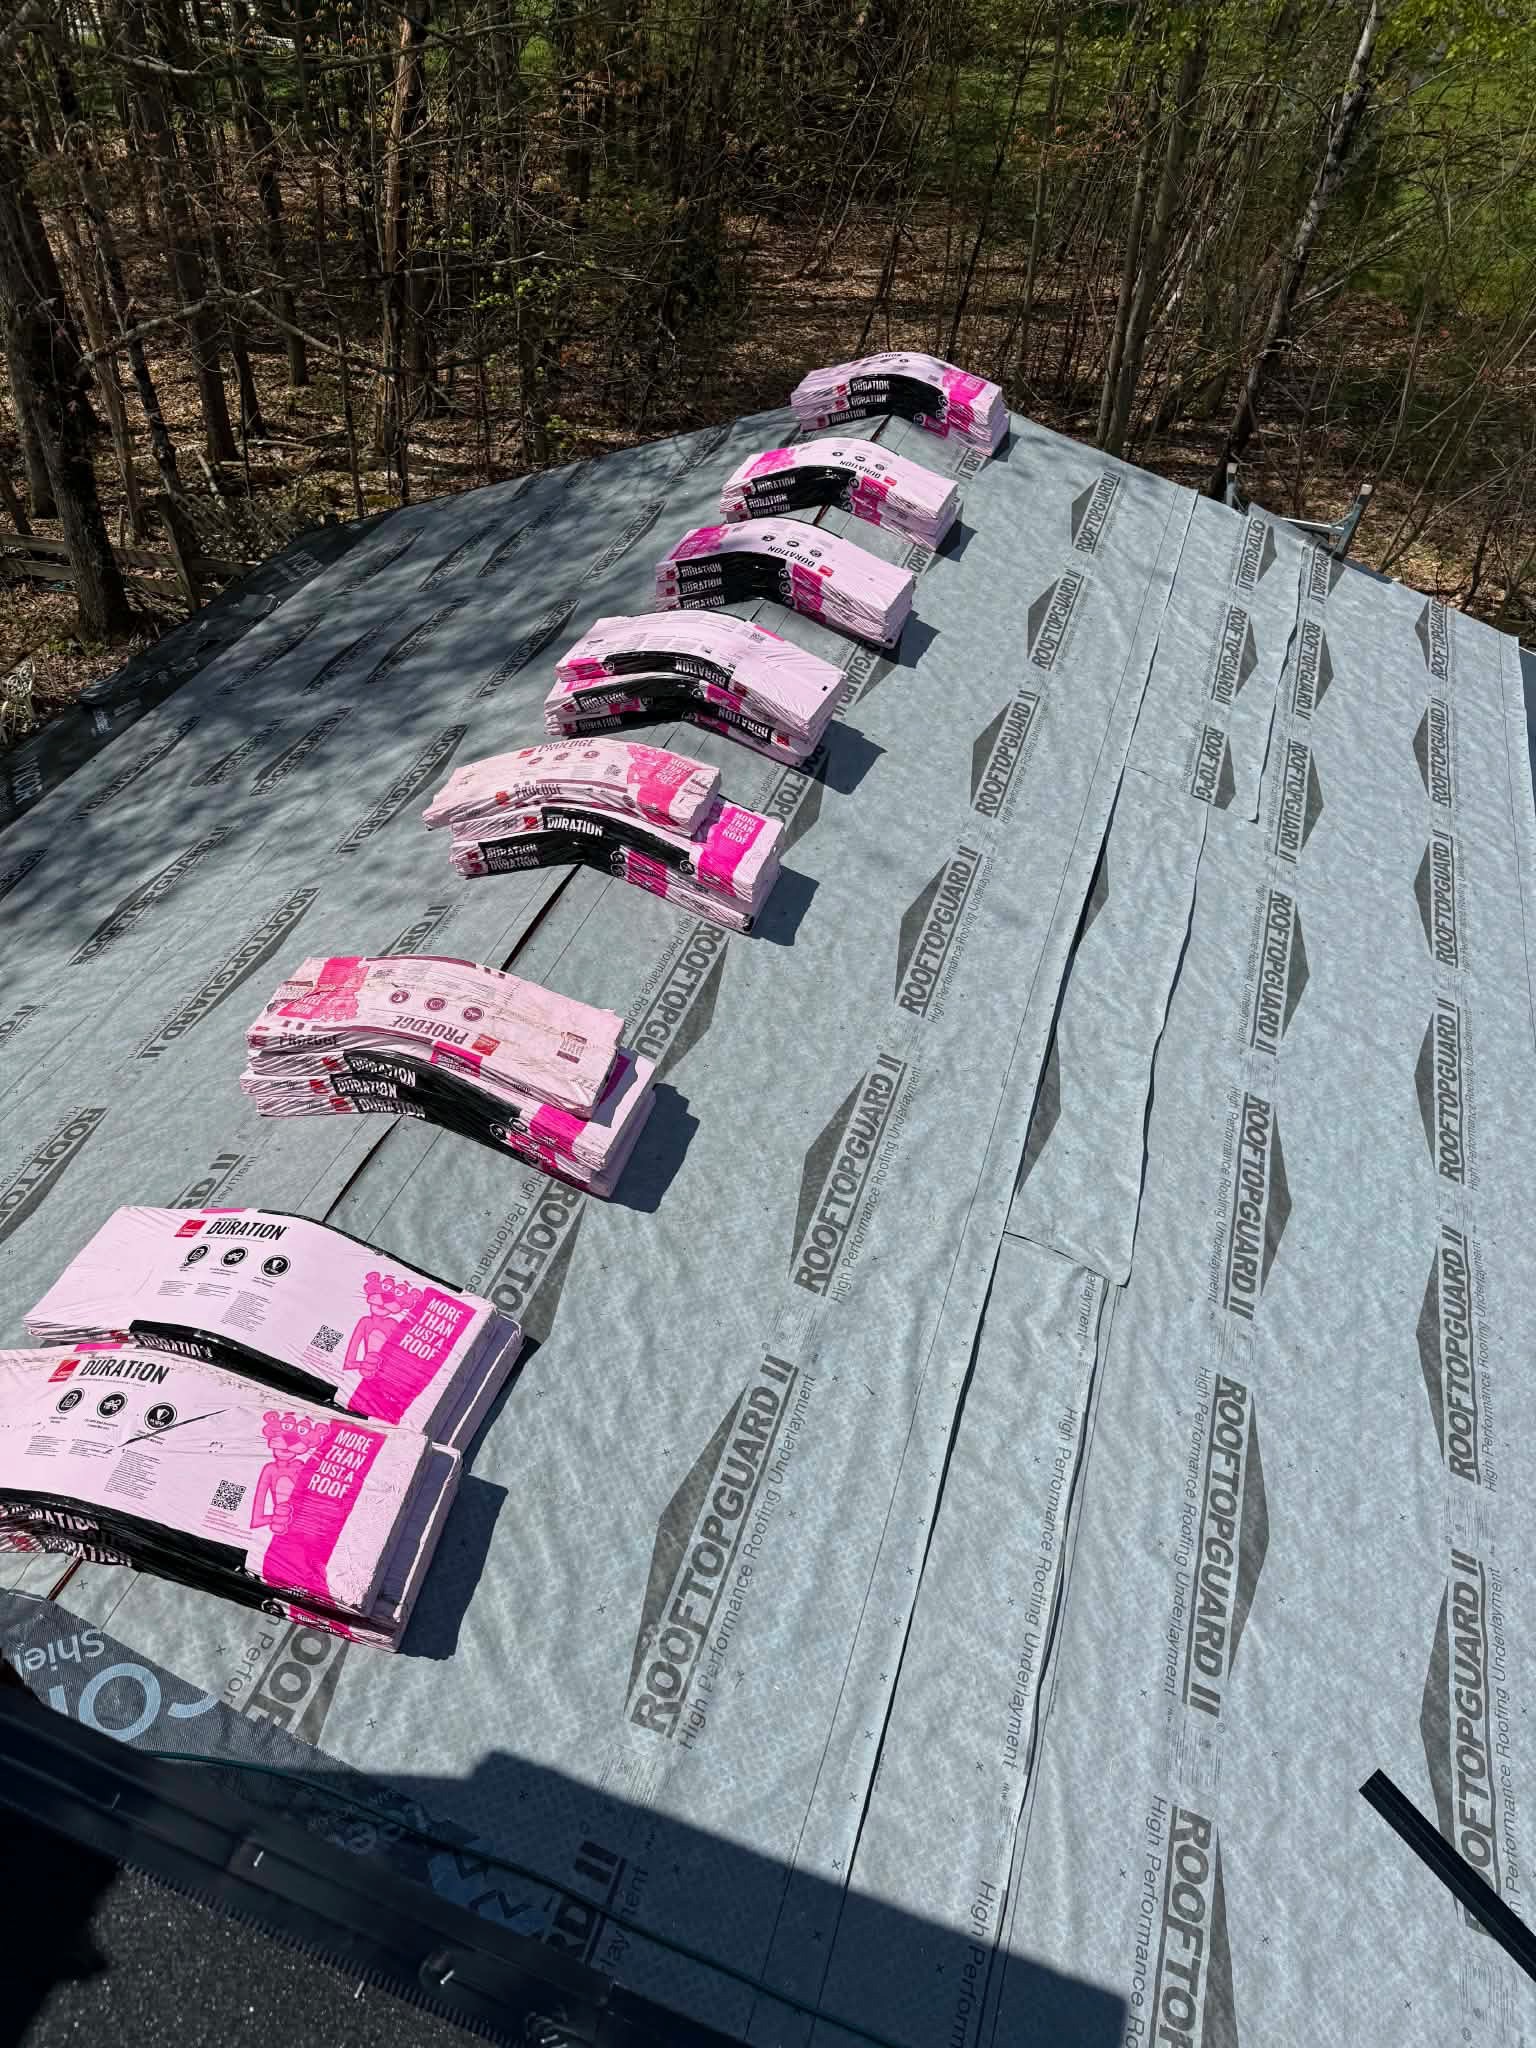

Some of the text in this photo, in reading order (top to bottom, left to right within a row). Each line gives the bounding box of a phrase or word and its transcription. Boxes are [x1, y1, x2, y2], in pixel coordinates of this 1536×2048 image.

[767, 546, 815, 567] DURATION
[1075, 477, 1118, 553] ROOFTOPGUARD
[1032, 577, 1077, 670] ROOFTOPGUARD
[1216, 606, 1247, 699] ROOFTOPGUARD
[1296, 621, 1321, 710] ROOFTOPGUARD
[975, 690, 1037, 818] ROOFTOPGUARD II
[1280, 741, 1308, 851] ROOFTOPGUARD
[1431, 707, 1447, 808] ROOFTOPGUARD
[547, 816, 603, 837] DURATION
[899, 845, 979, 1015] ROOFTOPGUARD II
[1432, 841, 1455, 967] ROOFTOPGUARD
[161, 887, 320, 1041] ROOFTOPGUARD
[1254, 890, 1292, 1056] ROOFTOPGUARD II
[140, 1046, 168, 1059] II
[389, 1015, 469, 1045] PROEDGE
[1434, 998, 1462, 1183] ROOFTOPGUARD II
[793, 1053, 903, 1296] ROOFTOPGUARD II
[831, 1065, 922, 1303] High Performance Roofing Underlayment
[1228, 1095, 1271, 1321] ROOFTOPGUARD II
[206, 1220, 288, 1241] DURATION
[465, 1171, 547, 1293] High Performance
[400, 1334, 441, 1361] ROOF
[410, 1324, 447, 1350] JUST A
[419, 1311, 456, 1337] THAN
[428, 1298, 464, 1324] MORE
[1440, 1224, 1475, 1482] ROOFTOPGUARD II
[79, 1358, 170, 1385] DURATION
[1477, 1373, 1495, 1460] Performance
[324, 1445, 367, 1472] THAN
[334, 1429, 375, 1454] MORE
[1058, 1407, 1078, 1442] High
[307, 1475, 351, 1499] ROOF
[316, 1462, 354, 1483] JUST A
[1041, 1448, 1072, 1552] Performance
[1483, 1462, 1497, 1493] High
[630, 1353, 795, 1738] ROOFTOPGUARD II
[679, 1374, 817, 1750] High Performance Roofing Underlayment
[1163, 1366, 1211, 1697] High Performance Roofing Underlayment
[1184, 1375, 1248, 1718] ROOFTOPGUARD II
[1450, 1548, 1480, 1577] II
[1490, 1567, 1511, 1684] Underlayment
[1001, 1632, 1036, 1770] Underlayment
[1496, 1687, 1513, 1761] Roofing
[1145, 1795, 1166, 1845] High
[1501, 1766, 1521, 1895] Performance
[970, 1880, 997, 1937] High
[1130, 1852, 1163, 2008] Performance
